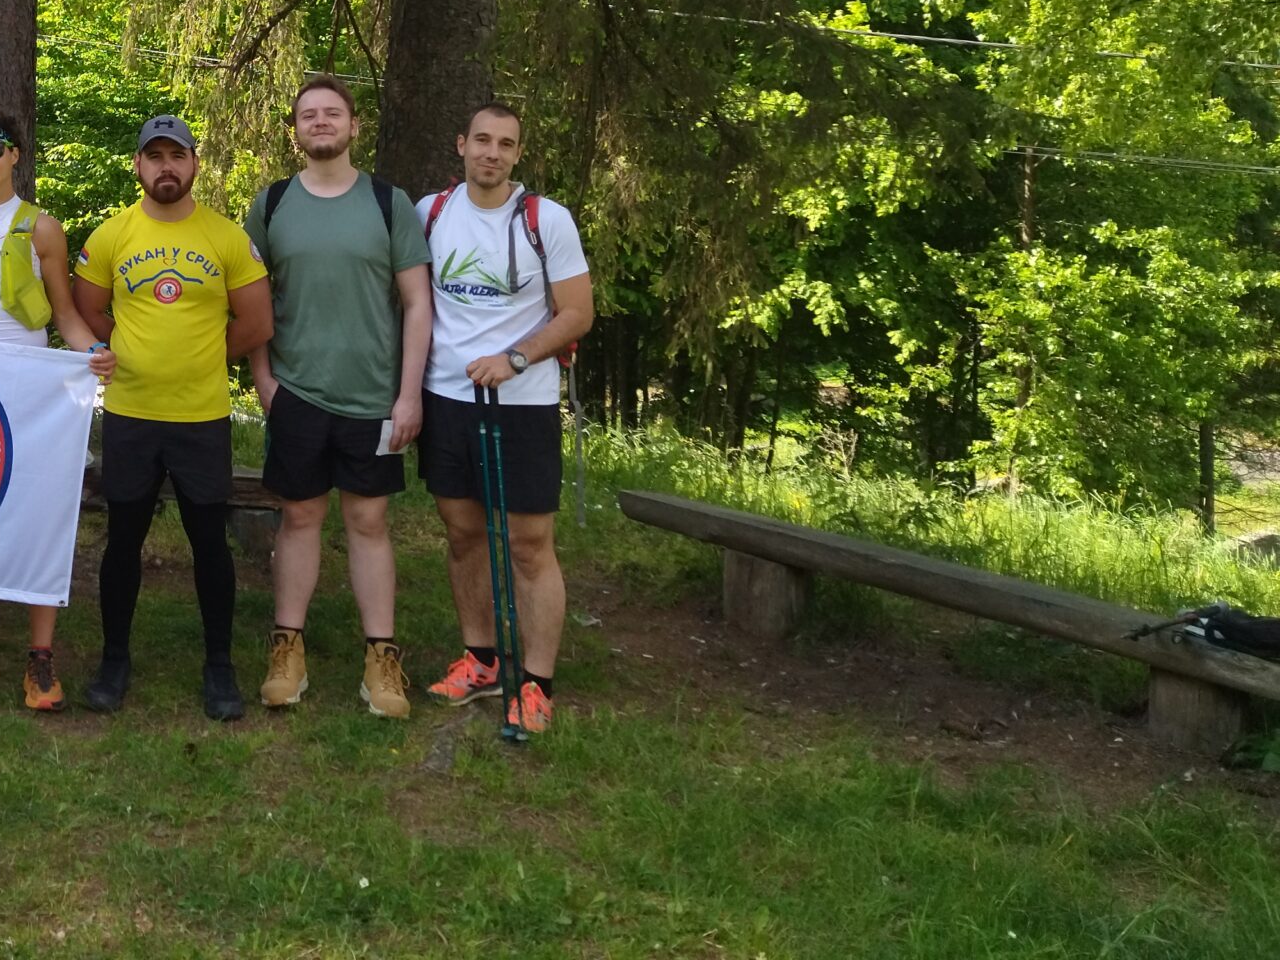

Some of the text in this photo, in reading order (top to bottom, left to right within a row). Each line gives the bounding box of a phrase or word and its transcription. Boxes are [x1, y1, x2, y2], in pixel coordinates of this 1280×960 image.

[118, 247, 166, 276] ВУКАН
[172, 247, 181, 258] У
[185, 251, 220, 277] СРЦУ
[441, 284, 467, 295] ULTRA
